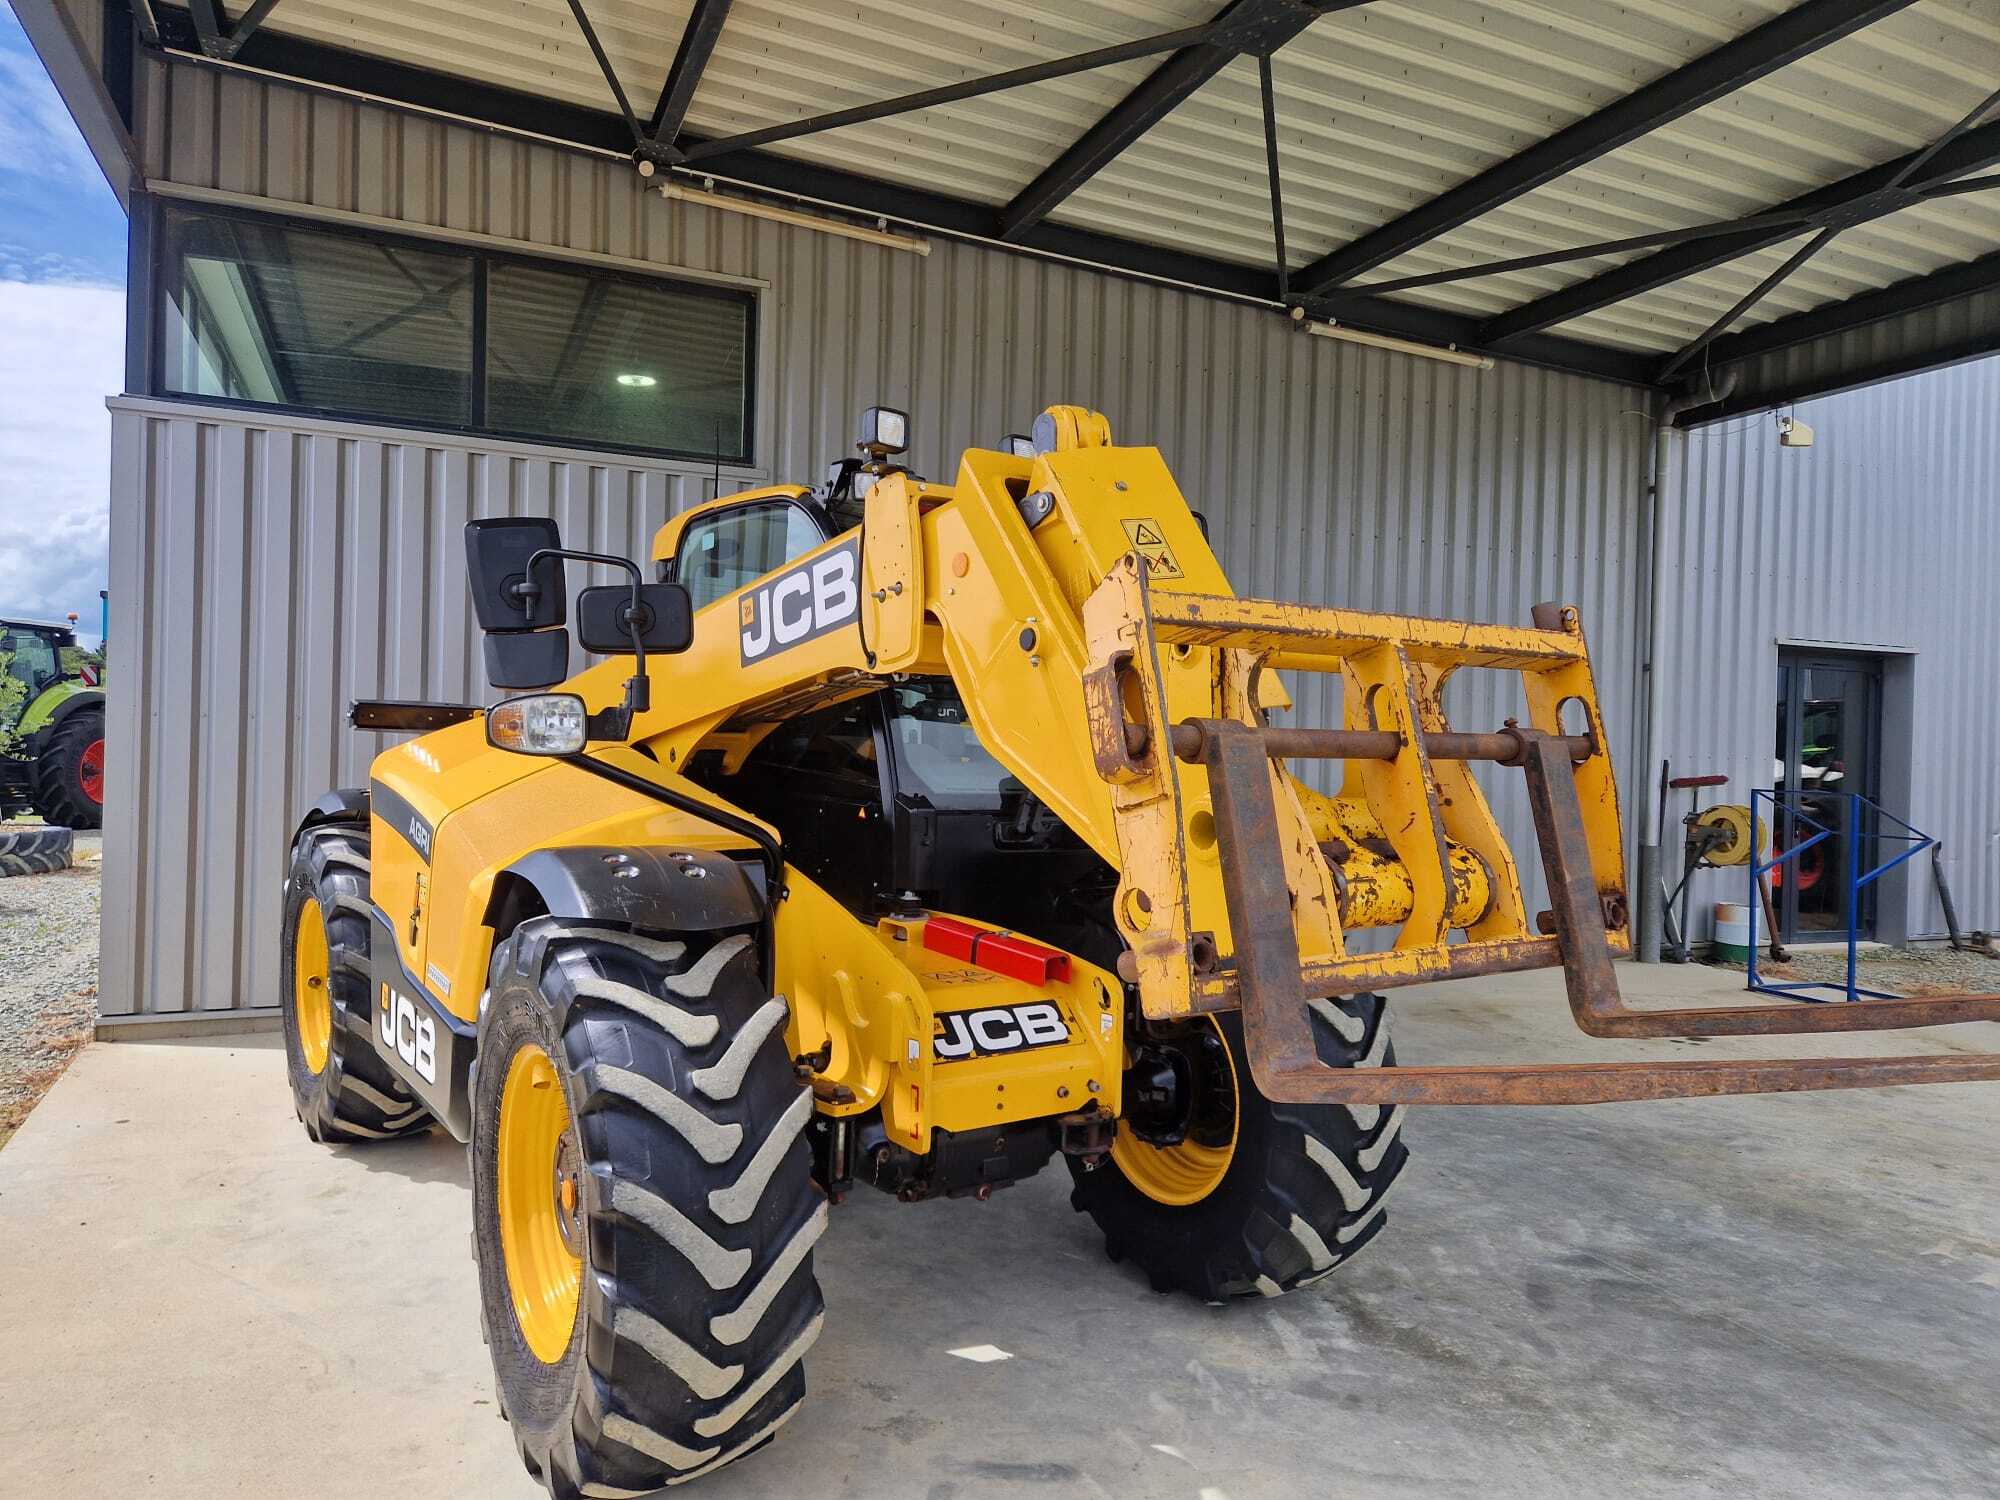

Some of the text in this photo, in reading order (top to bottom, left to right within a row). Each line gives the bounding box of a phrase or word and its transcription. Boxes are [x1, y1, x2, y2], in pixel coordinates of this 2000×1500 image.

[742, 550, 858, 658] JCB
[408, 816, 430, 855] AGRI
[380, 987, 436, 1084] JCB
[934, 1004, 1068, 1057] JCB
